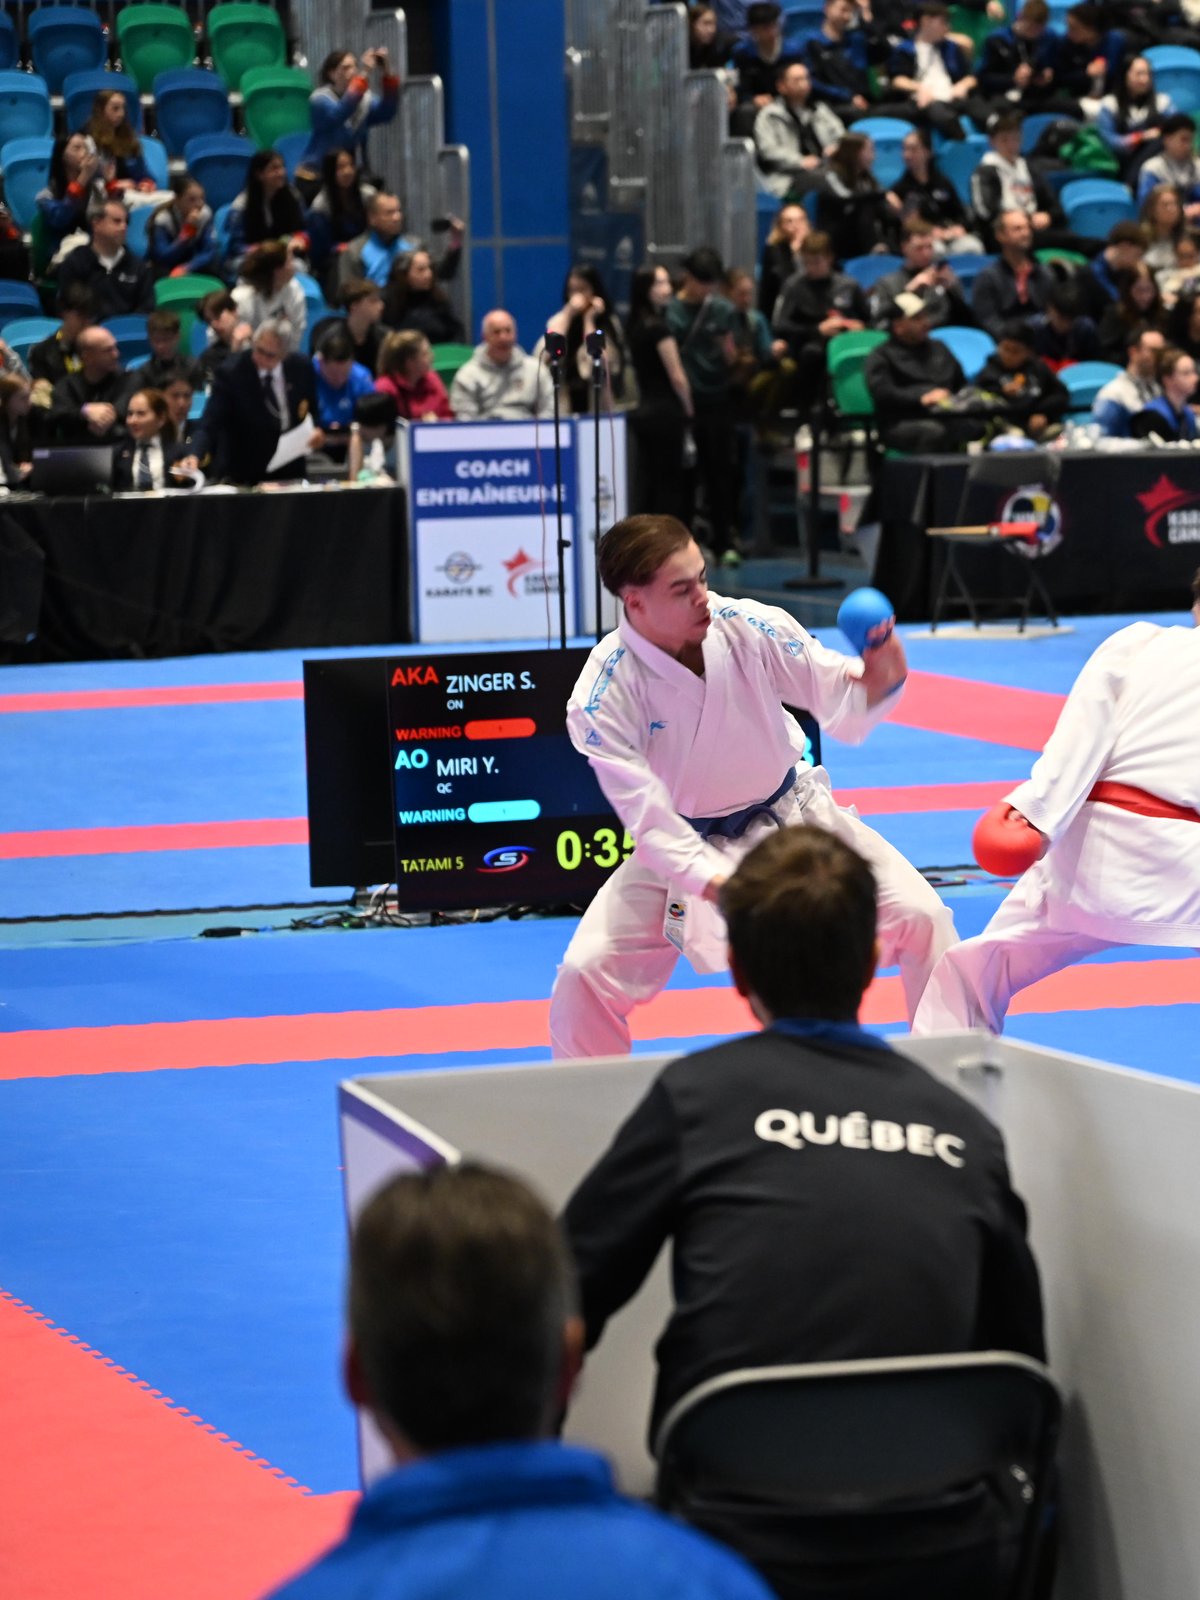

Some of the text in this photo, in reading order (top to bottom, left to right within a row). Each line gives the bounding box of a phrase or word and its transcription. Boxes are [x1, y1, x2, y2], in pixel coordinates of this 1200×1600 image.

[455, 458, 531, 479] COACH
[391, 666, 536, 693] AKA ZINGER S.
[446, 700, 464, 711] ON
[395, 726, 462, 741] WARNING
[394, 749, 499, 777] AO MIRI Y.
[436, 783, 453, 794] QC
[399, 808, 466, 825] WARNING
[400, 857, 465, 874] TATAMI 5
[754, 1108, 966, 1168] QUÉBEC
